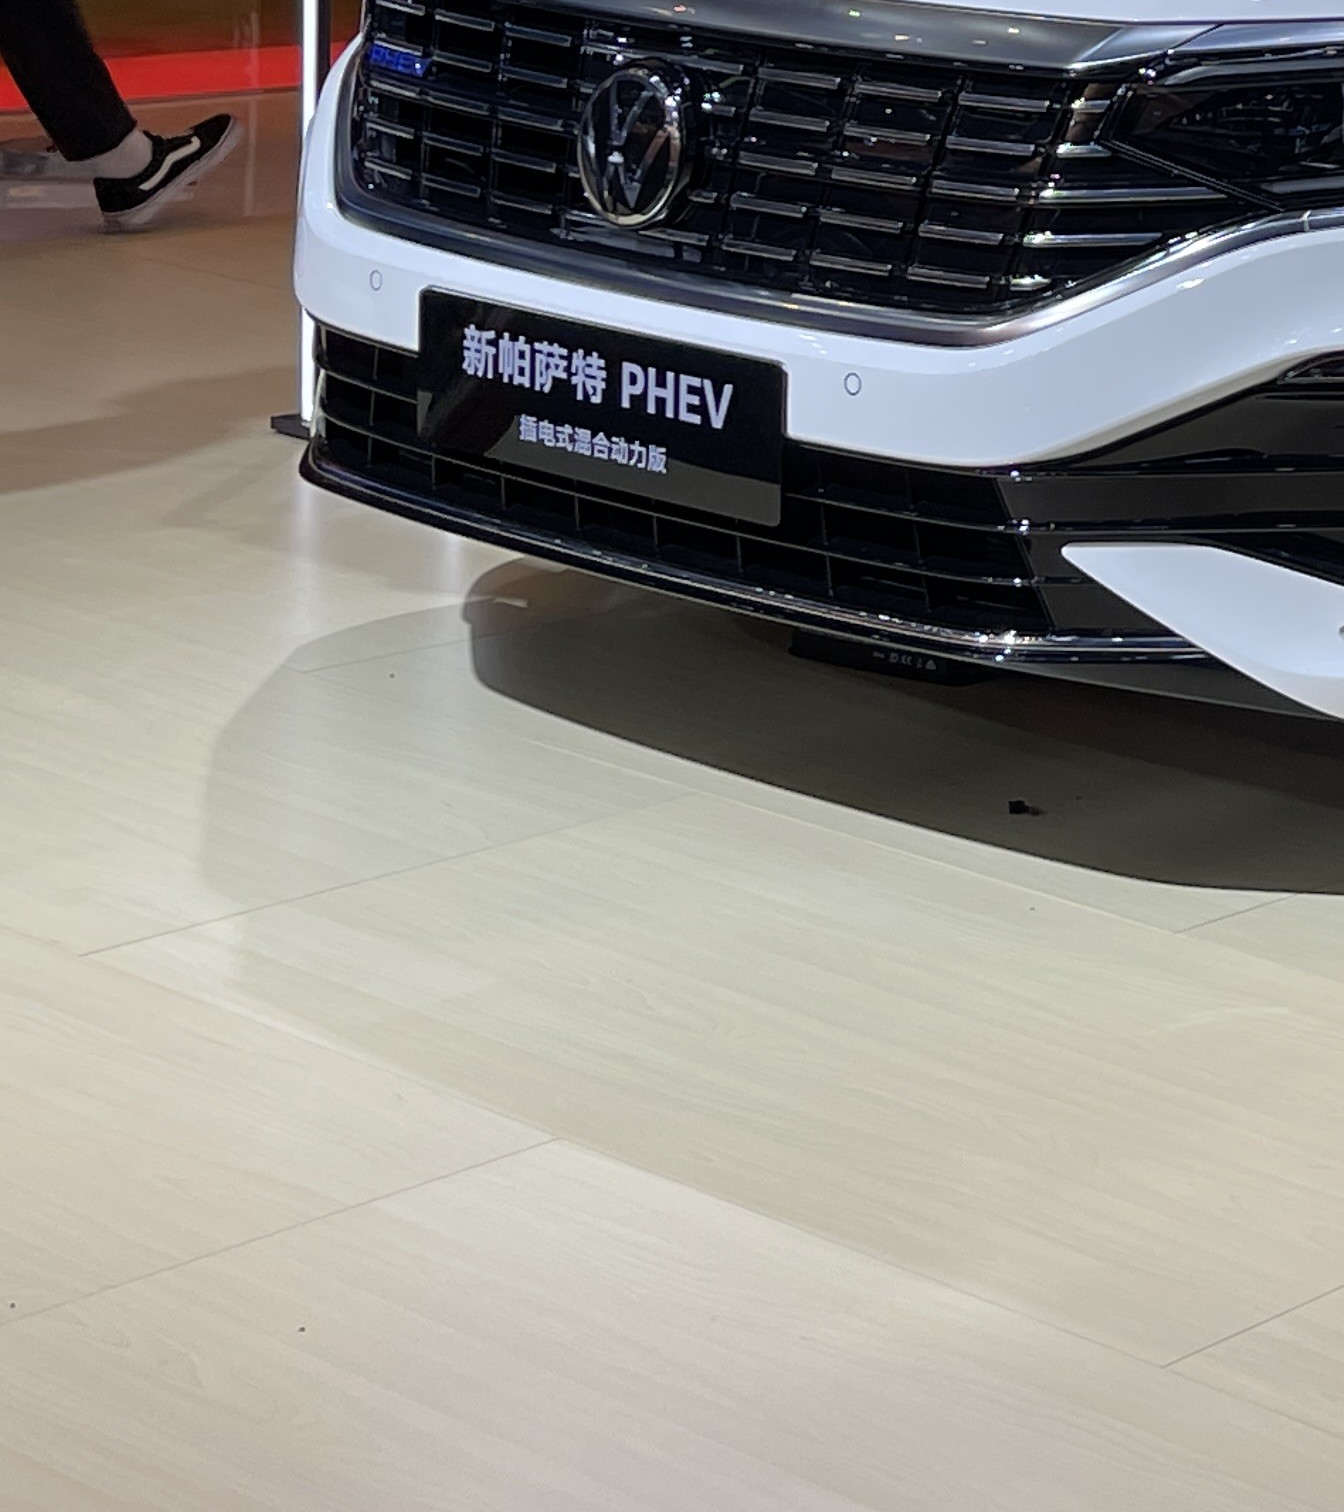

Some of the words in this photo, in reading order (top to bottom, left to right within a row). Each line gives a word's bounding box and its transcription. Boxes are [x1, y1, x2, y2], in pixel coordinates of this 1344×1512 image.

[462, 324, 607, 404] 新帕萨特
[621, 361, 733, 430] PHEV
[519, 413, 668, 474] 插电式混合动力版
